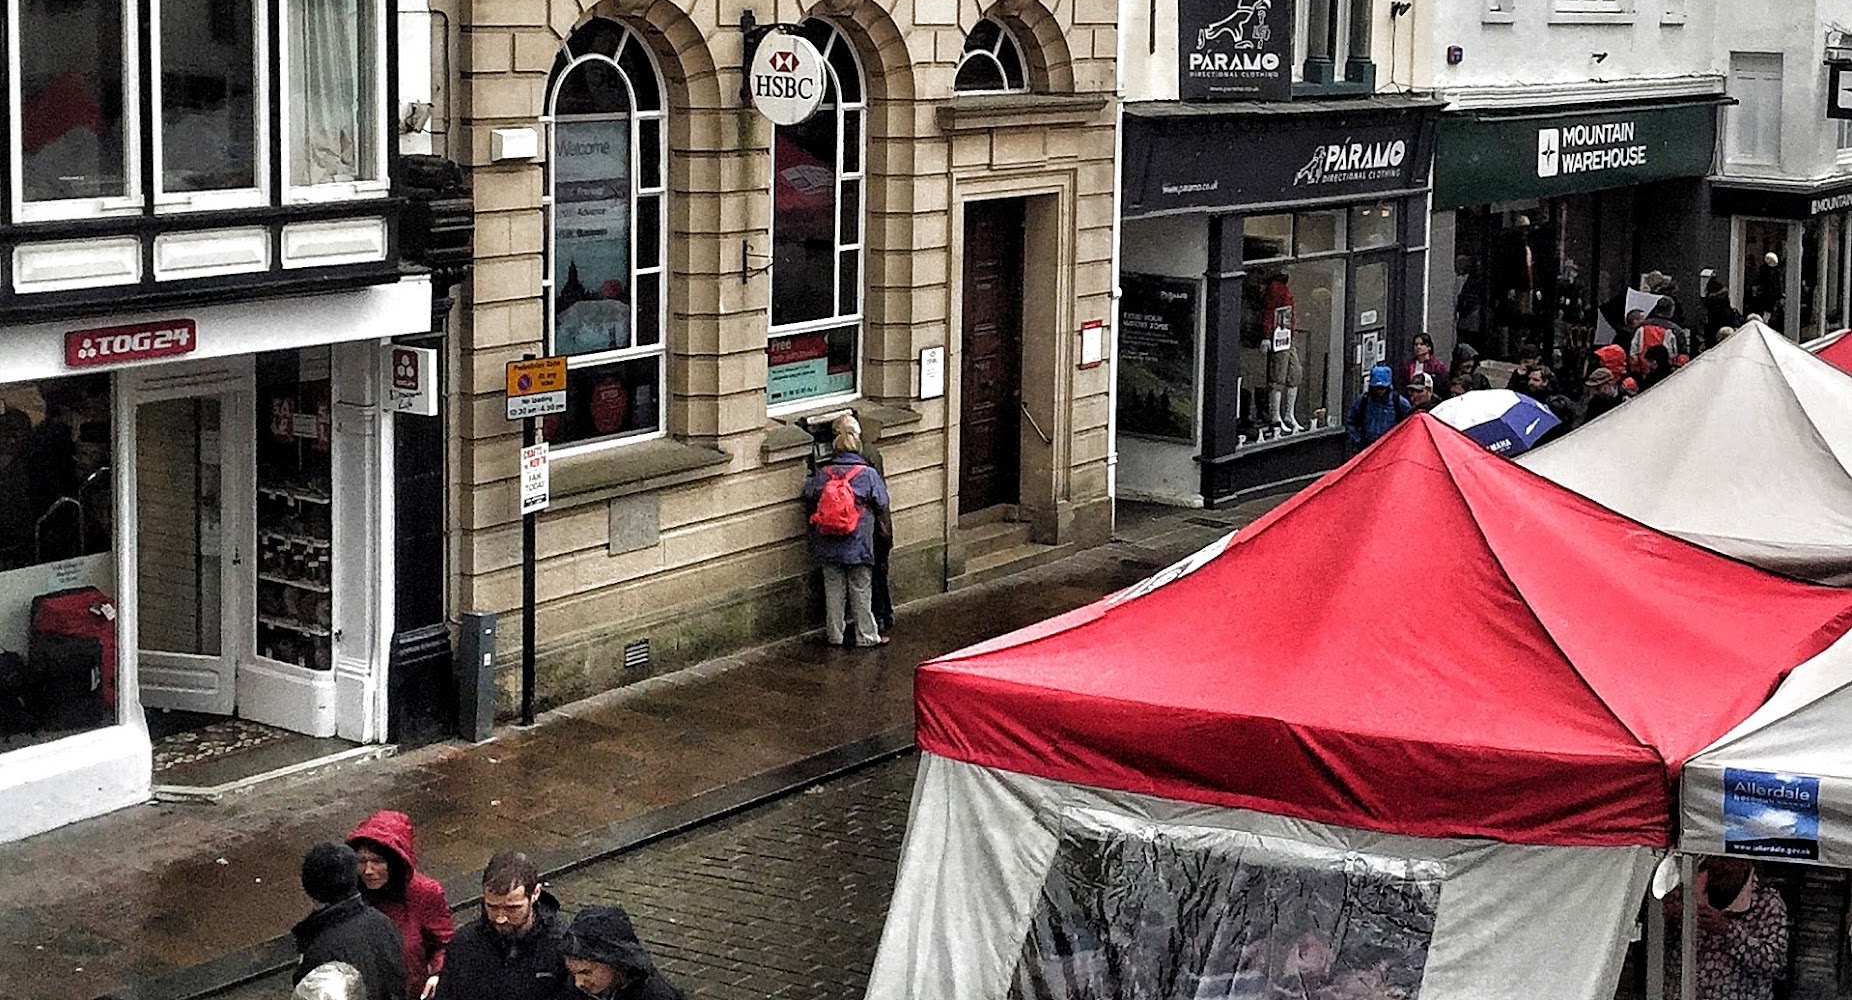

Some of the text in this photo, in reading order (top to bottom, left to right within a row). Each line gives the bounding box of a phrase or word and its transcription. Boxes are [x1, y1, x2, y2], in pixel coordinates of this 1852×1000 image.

[1189, 49, 1280, 71] PÁRAMO
[1241, 71, 1280, 79] CLOTHING
[755, 74, 814, 99] HSBC
[1562, 121, 1635, 148] MOUNTAIN
[555, 140, 610, 157] Welcome
[1324, 136, 1406, 172] PÁRAMO
[1561, 145, 1647, 174] WAREHOUSE
[1321, 168, 1401, 183] DIRECTIONAL CLOTHING
[95, 327, 190, 355] TOG24
[771, 339, 792, 353] Free
[1734, 781, 1811, 801] Allerdale
